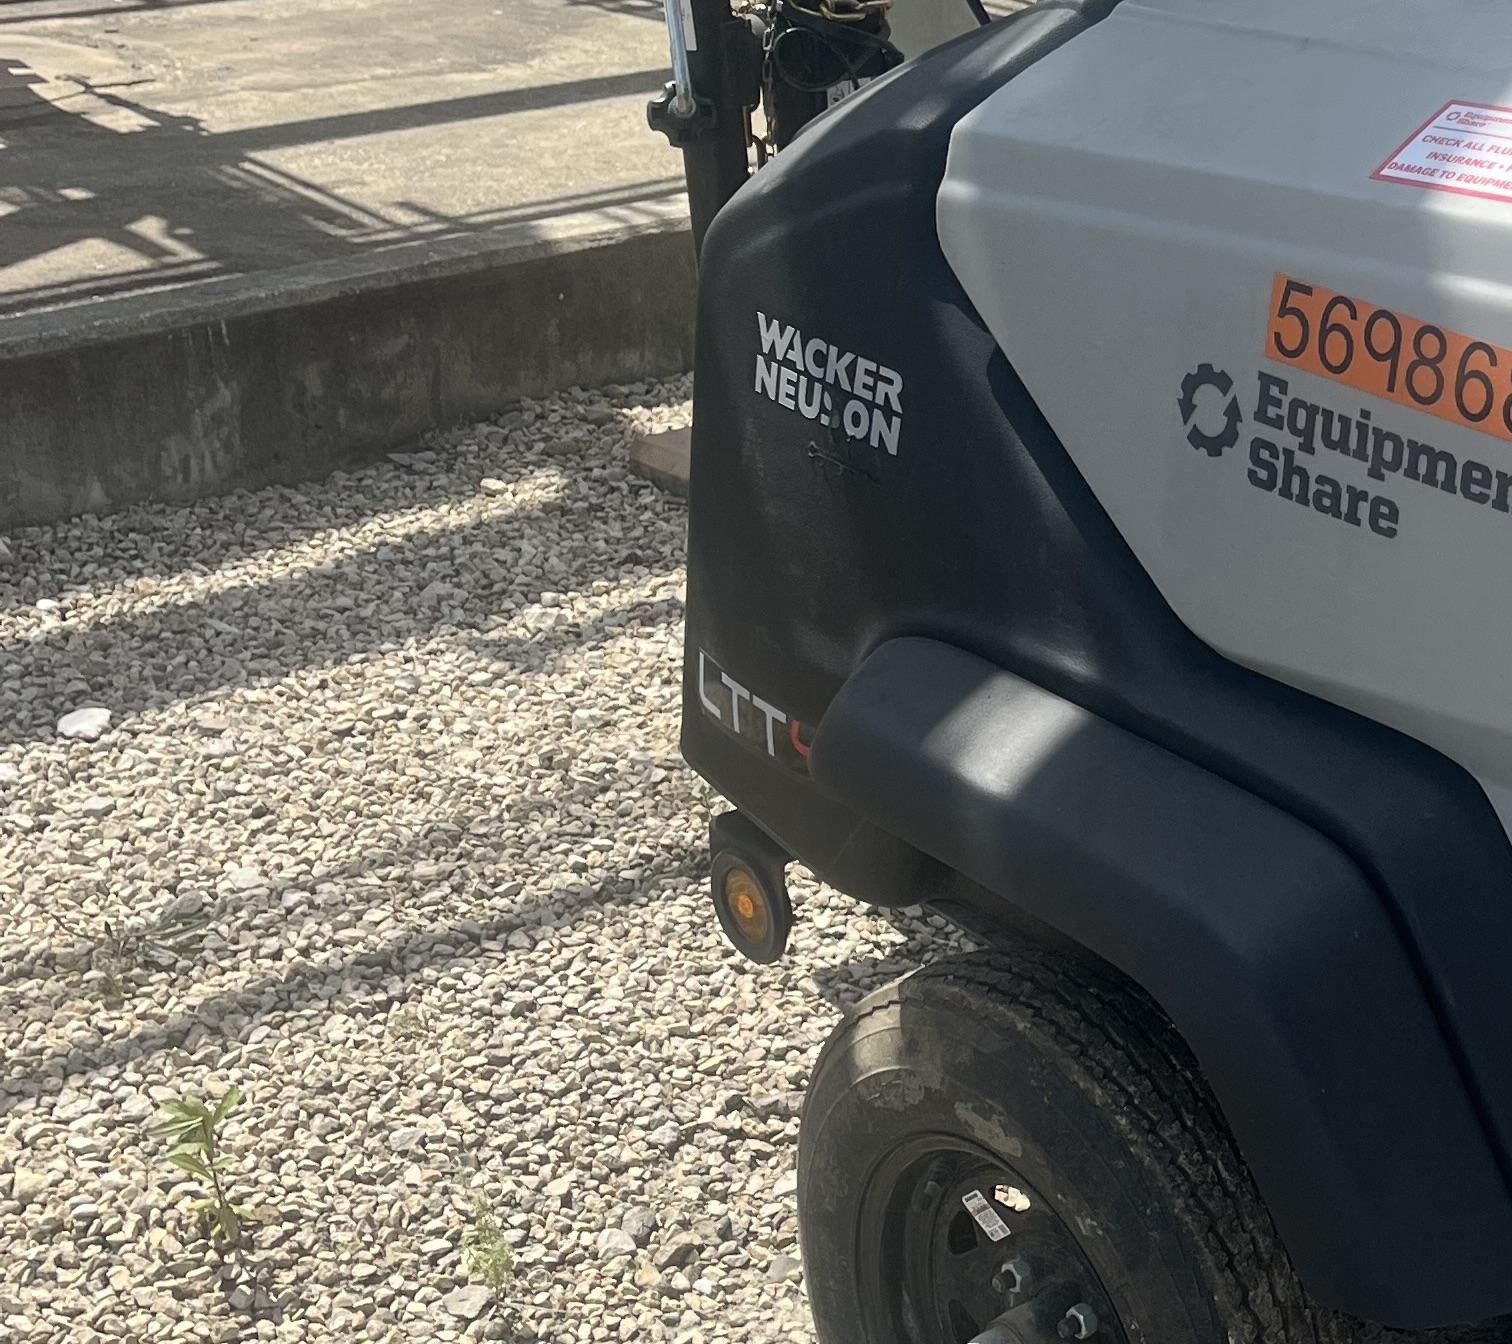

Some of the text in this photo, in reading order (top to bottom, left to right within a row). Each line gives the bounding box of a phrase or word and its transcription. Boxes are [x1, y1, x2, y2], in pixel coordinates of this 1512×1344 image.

[1421, 134, 1462, 148] CHECK
[1463, 140, 1484, 152] ALL
[1387, 161, 1440, 177] DAMAGE
[1439, 170, 1457, 179] TO
[1425, 151, 1496, 170] INSURANCE
[756, 311, 904, 414] WACKER
[1247, 439, 1400, 539] Share
